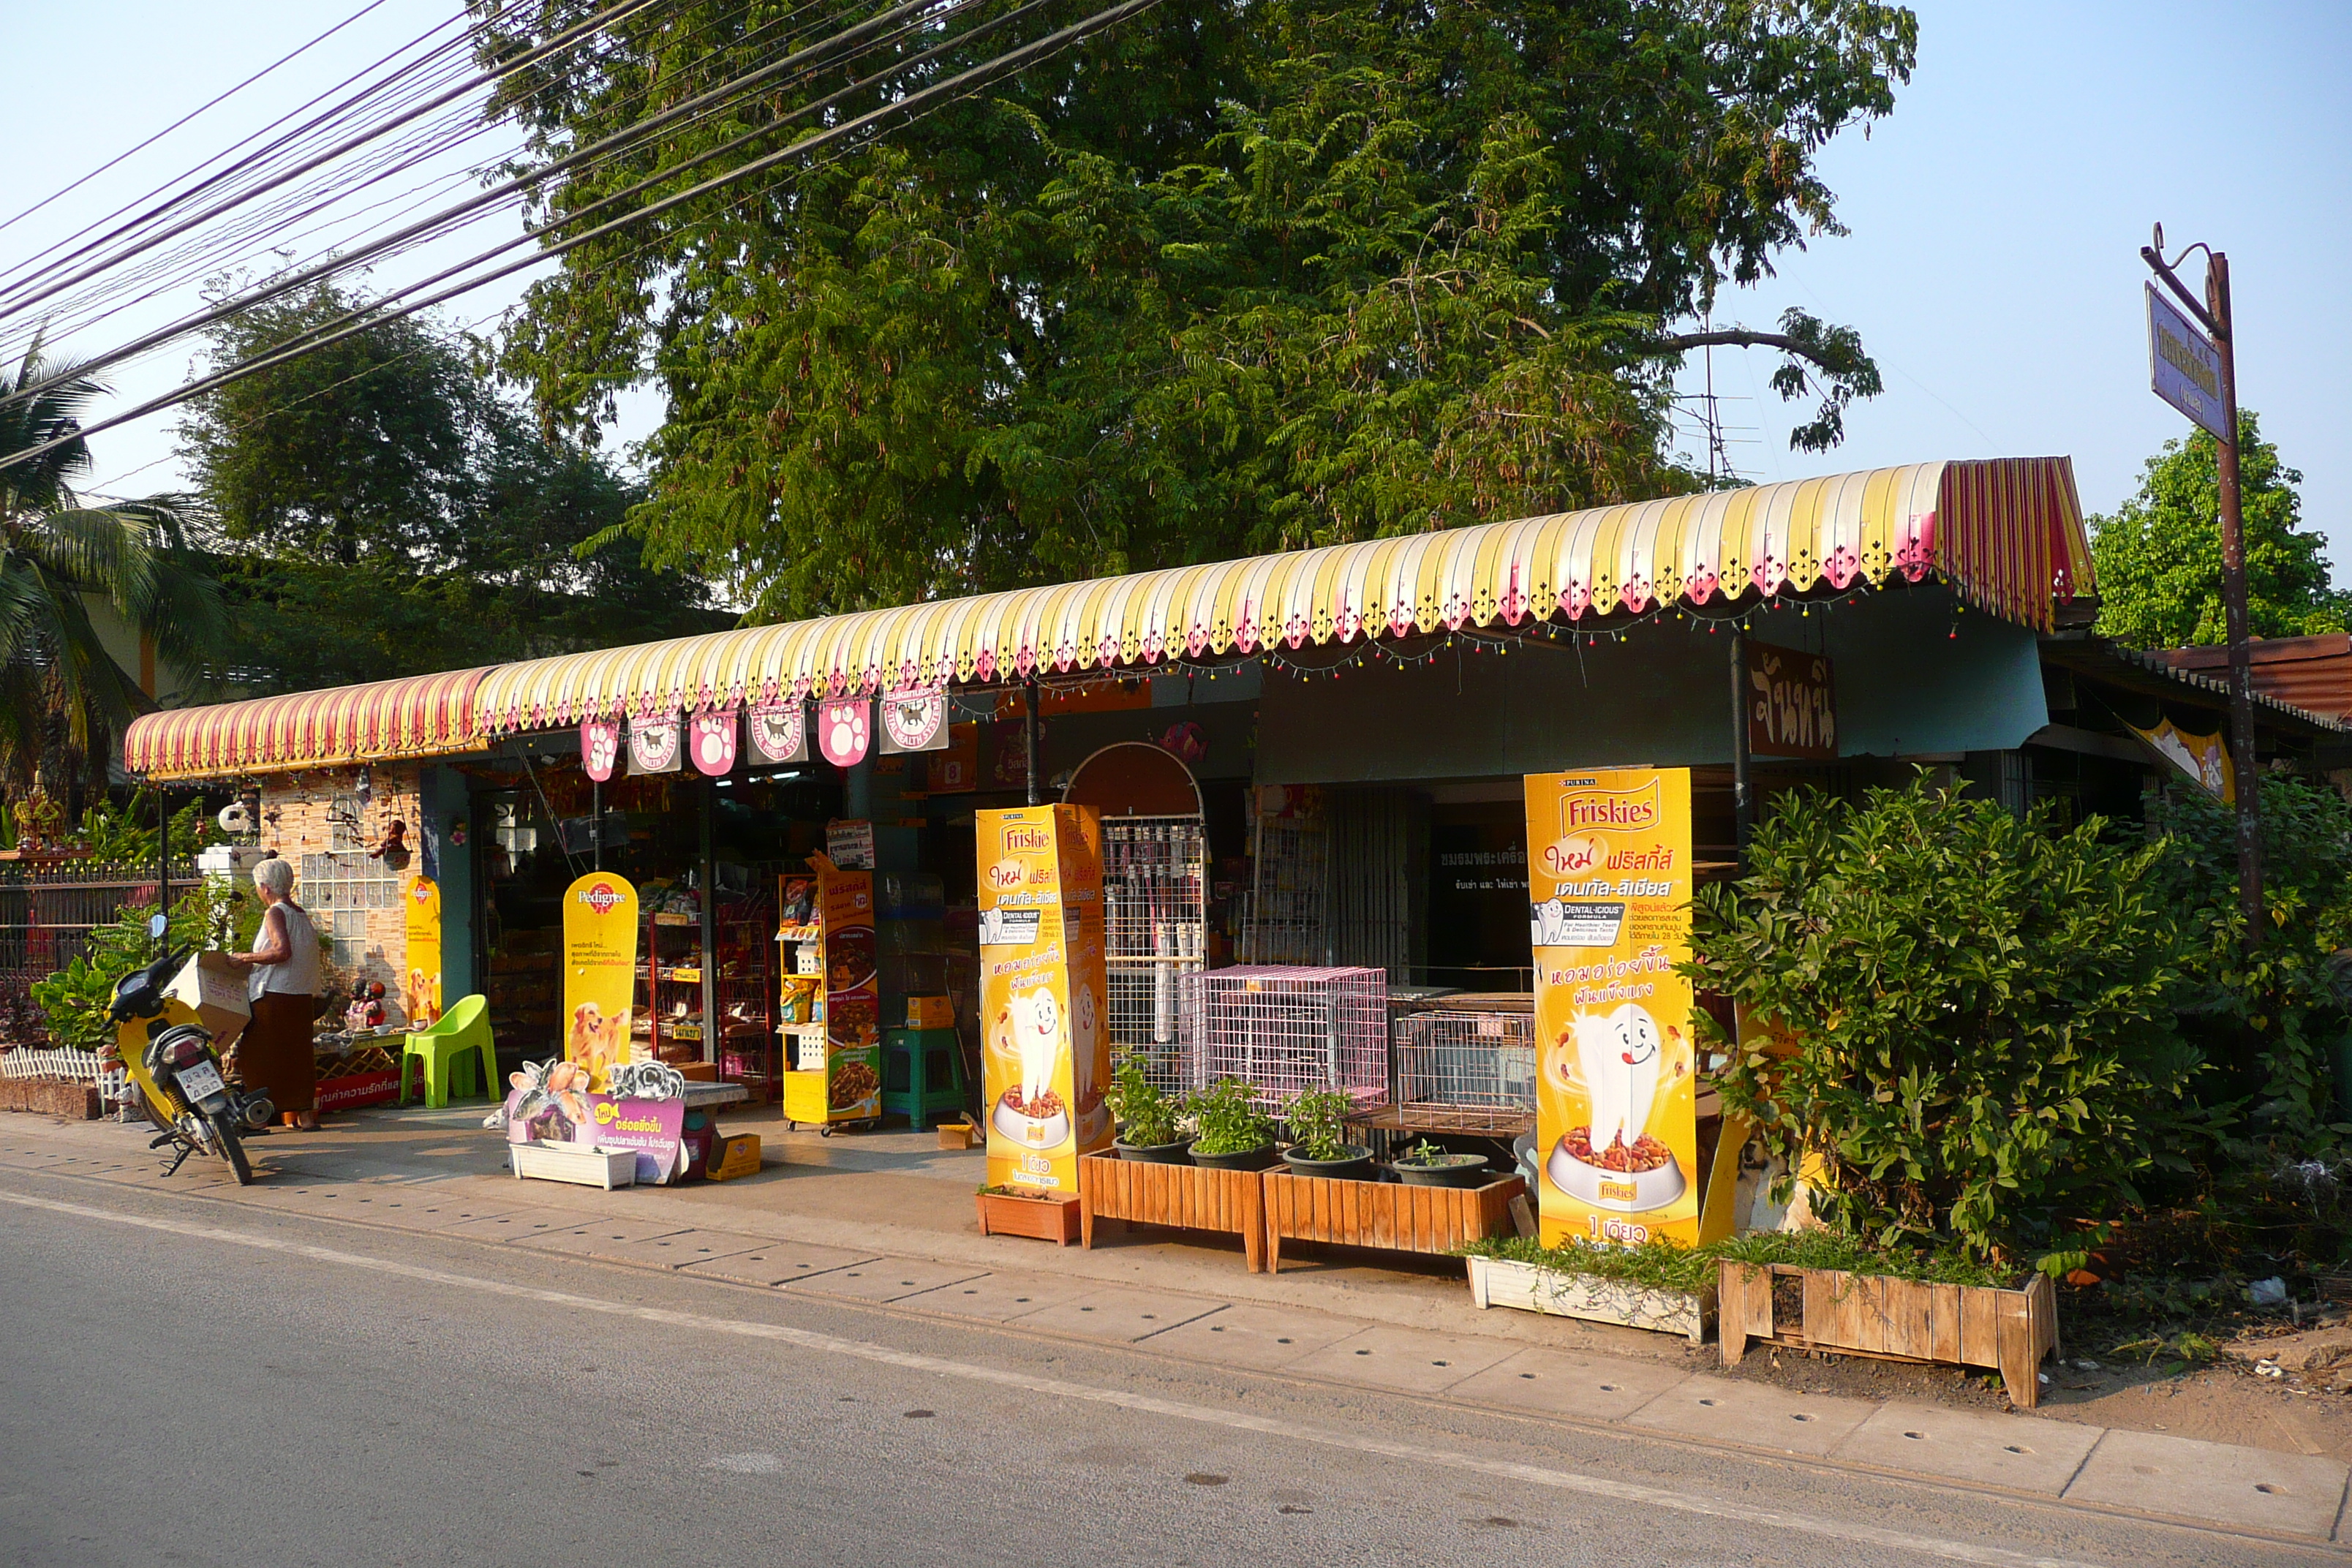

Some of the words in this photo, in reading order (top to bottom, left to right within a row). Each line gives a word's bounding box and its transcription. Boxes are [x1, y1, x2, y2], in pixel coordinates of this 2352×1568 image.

[886, 687, 932, 700] Eukanuba
[896, 731, 922, 745] HEALTH
[922, 701, 939, 739] SYSTEM
[754, 720, 763, 745] VITAL
[763, 743, 785, 757] HEALTH
[786, 718, 800, 753] SYSTEM
[1569, 797, 1652, 827] Friskies
[1006, 828, 1049, 851] Friskies
[1440, 840, 1529, 866] ชมรมพระเครื่อ
[1545, 838, 1594, 873] ใหม่
[1607, 844, 1673, 870] ฟริสกี้ส์
[989, 859, 1023, 888] ใหม่
[578, 889, 626, 907] Pedigree
[1555, 878, 1672, 897] เดนทัล-ลิเชียส
[1628, 930, 1659, 940] ได้ดีภายใน
[1629, 923, 1681, 932] ของคราบหินปูน
[1550, 946, 1670, 984] หอมอร่อยขึ้น
[1575, 981, 1654, 1006] ฟันแข็งแรง
[598, 1107, 611, 1119] ใหม่
[616, 1115, 662, 1132] อร่อยยิ่งขึ้น
[1602, 1184, 1635, 1198] Friskies
[1605, 1219, 1646, 1242] เดียว
